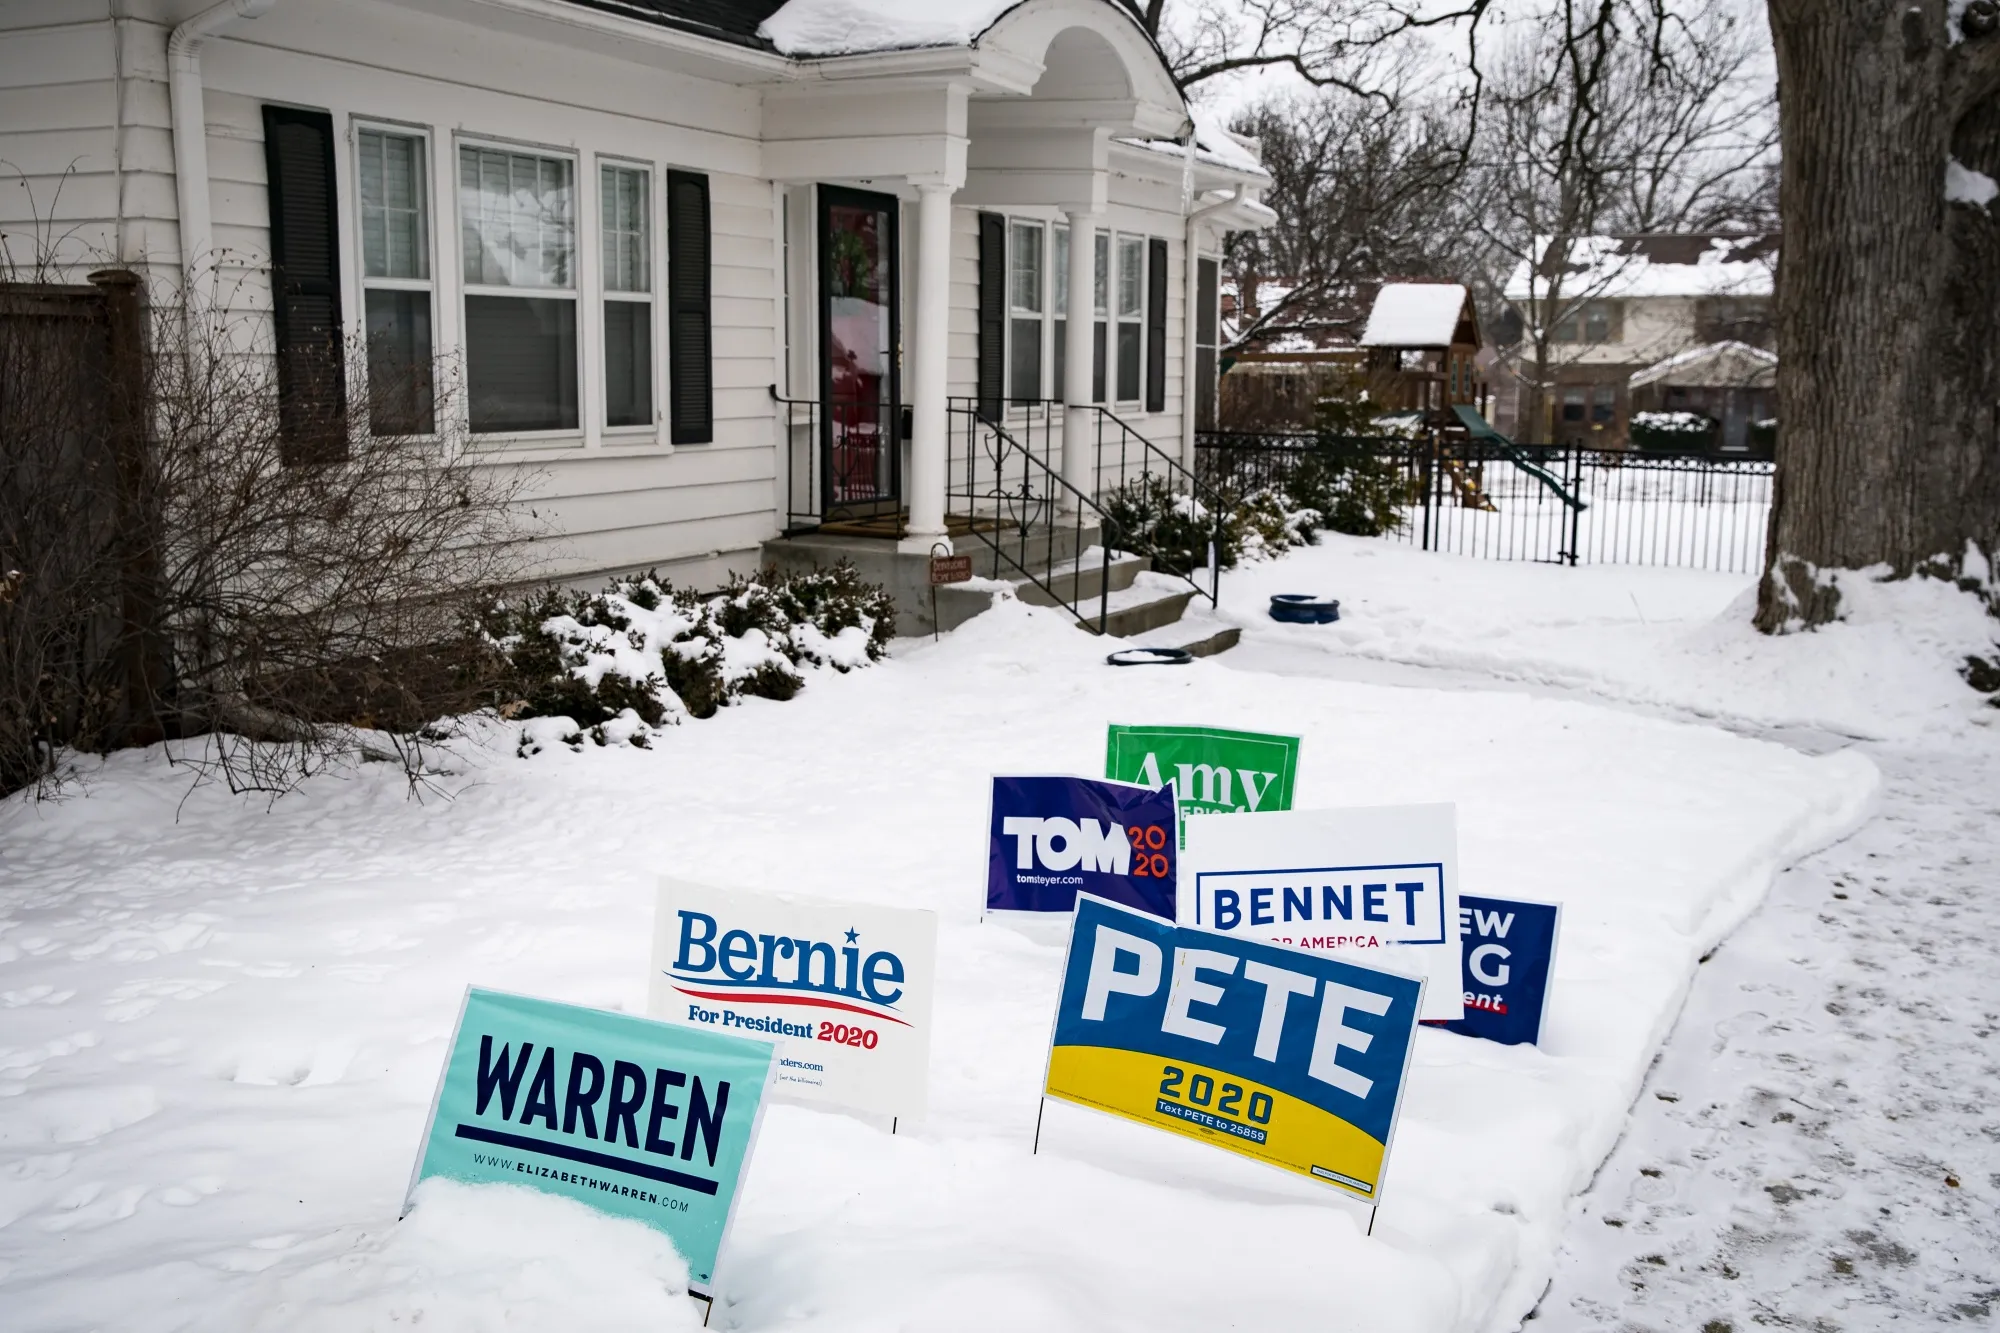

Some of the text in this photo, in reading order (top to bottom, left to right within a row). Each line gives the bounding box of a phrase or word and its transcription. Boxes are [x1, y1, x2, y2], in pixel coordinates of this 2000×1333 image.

[1135, 752, 1277, 813] Amy
[1003, 816, 1166, 876] TOM 20
[1133, 853, 1168, 878] 20
[1016, 874, 1083, 886] tomsteyer.com
[1214, 882, 1424, 930] BENNET
[673, 910, 905, 1005] Bernie
[688, 1004, 879, 1050] For President 2020
[1081, 924, 1393, 1100] PETE
[476, 1035, 730, 1168] WARREN
[1158, 1101, 1183, 1116] Text
[1184, 1109, 1214, 1126] PETE
[1216, 1118, 1228, 1130] to
[1229, 1123, 1265, 1141] 25859
[1159, 1066, 1274, 1125] 2020
[474, 1153, 689, 1213] WWW.ELIZABETHWARREN.COM
